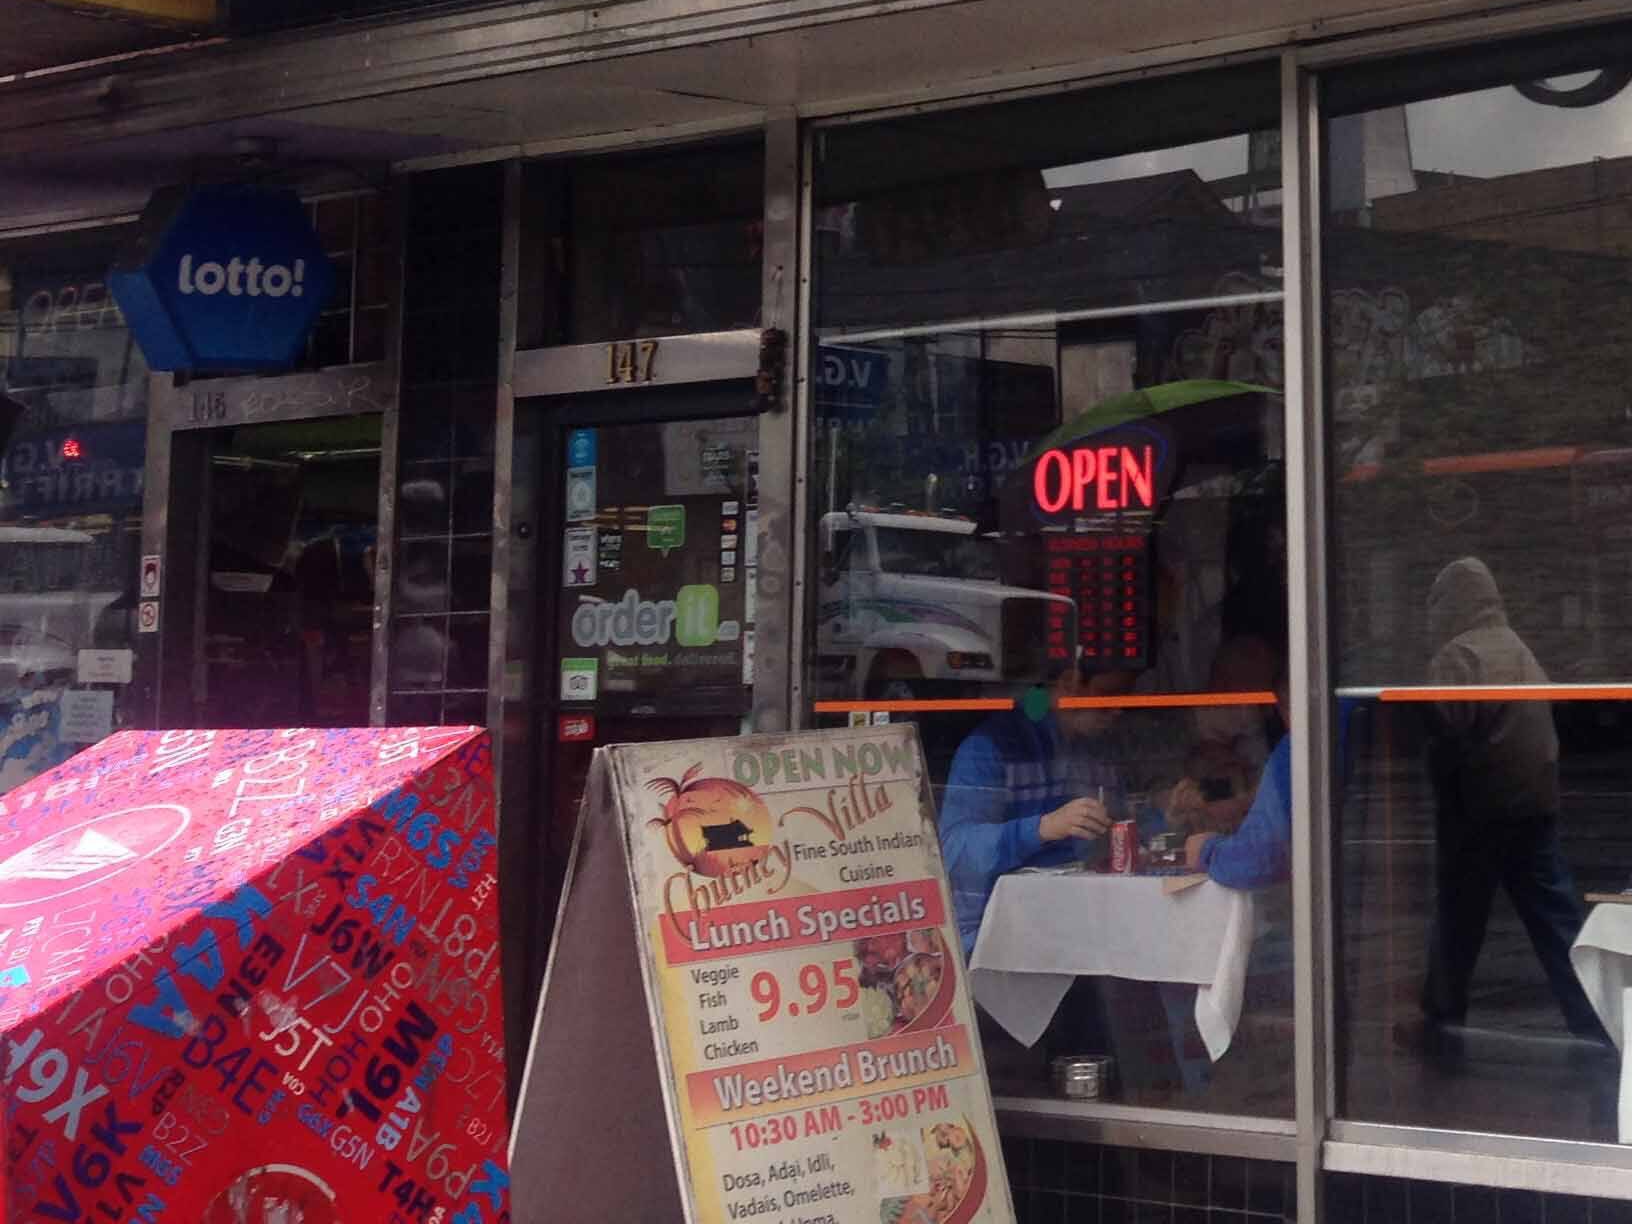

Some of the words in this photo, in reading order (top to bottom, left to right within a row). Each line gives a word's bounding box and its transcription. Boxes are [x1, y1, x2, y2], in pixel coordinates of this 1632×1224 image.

[177, 254, 305, 297] lotto!
[604, 340, 660, 385] 147
[1034, 445, 1154, 514] OPEN
[732, 745, 827, 786] OPEN
[833, 741, 914, 778] NOW
[664, 839, 793, 942] Chutney
[778, 773, 893, 840] Villa
[793, 843, 827, 861] Fine
[830, 837, 874, 857] South
[877, 832, 921, 851] Indian
[839, 863, 894, 883] Cuisine
[310, 902, 397, 979] J6W
[688, 909, 790, 951] Lunch
[798, 890, 926, 938] Specials
[127, 882, 273, 1040] K4A
[217, 934, 287, 1019] E3N
[690, 965, 739, 986] Veggie
[750, 959, 859, 1022] 9.95
[699, 991, 727, 1009] Fish
[699, 1015, 739, 1035] Lamb
[181, 1013, 280, 1114] B4E
[703, 1038, 759, 1060] Chicken
[713, 1053, 852, 1111] Weekend
[857, 1035, 957, 1085] Brunch
[152, 1111, 209, 1168] B2Z
[375, 1085, 422, 1151] A1B
[730, 1115, 798, 1151] 10:30
[803, 1106, 843, 1137] AM
[858, 1093, 909, 1125] 3:00
[914, 1084, 950, 1114] PM
[32, 1099, 145, 1223] V6K
[330, 1124, 376, 1172] G5N
[407, 1116, 479, 1201] P9A
[723, 1173, 766, 1193] Dosa,
[807, 1152, 836, 1172] Idli,
[727, 1196, 781, 1220] Vadais,
[783, 1179, 856, 1208] Omelette,
